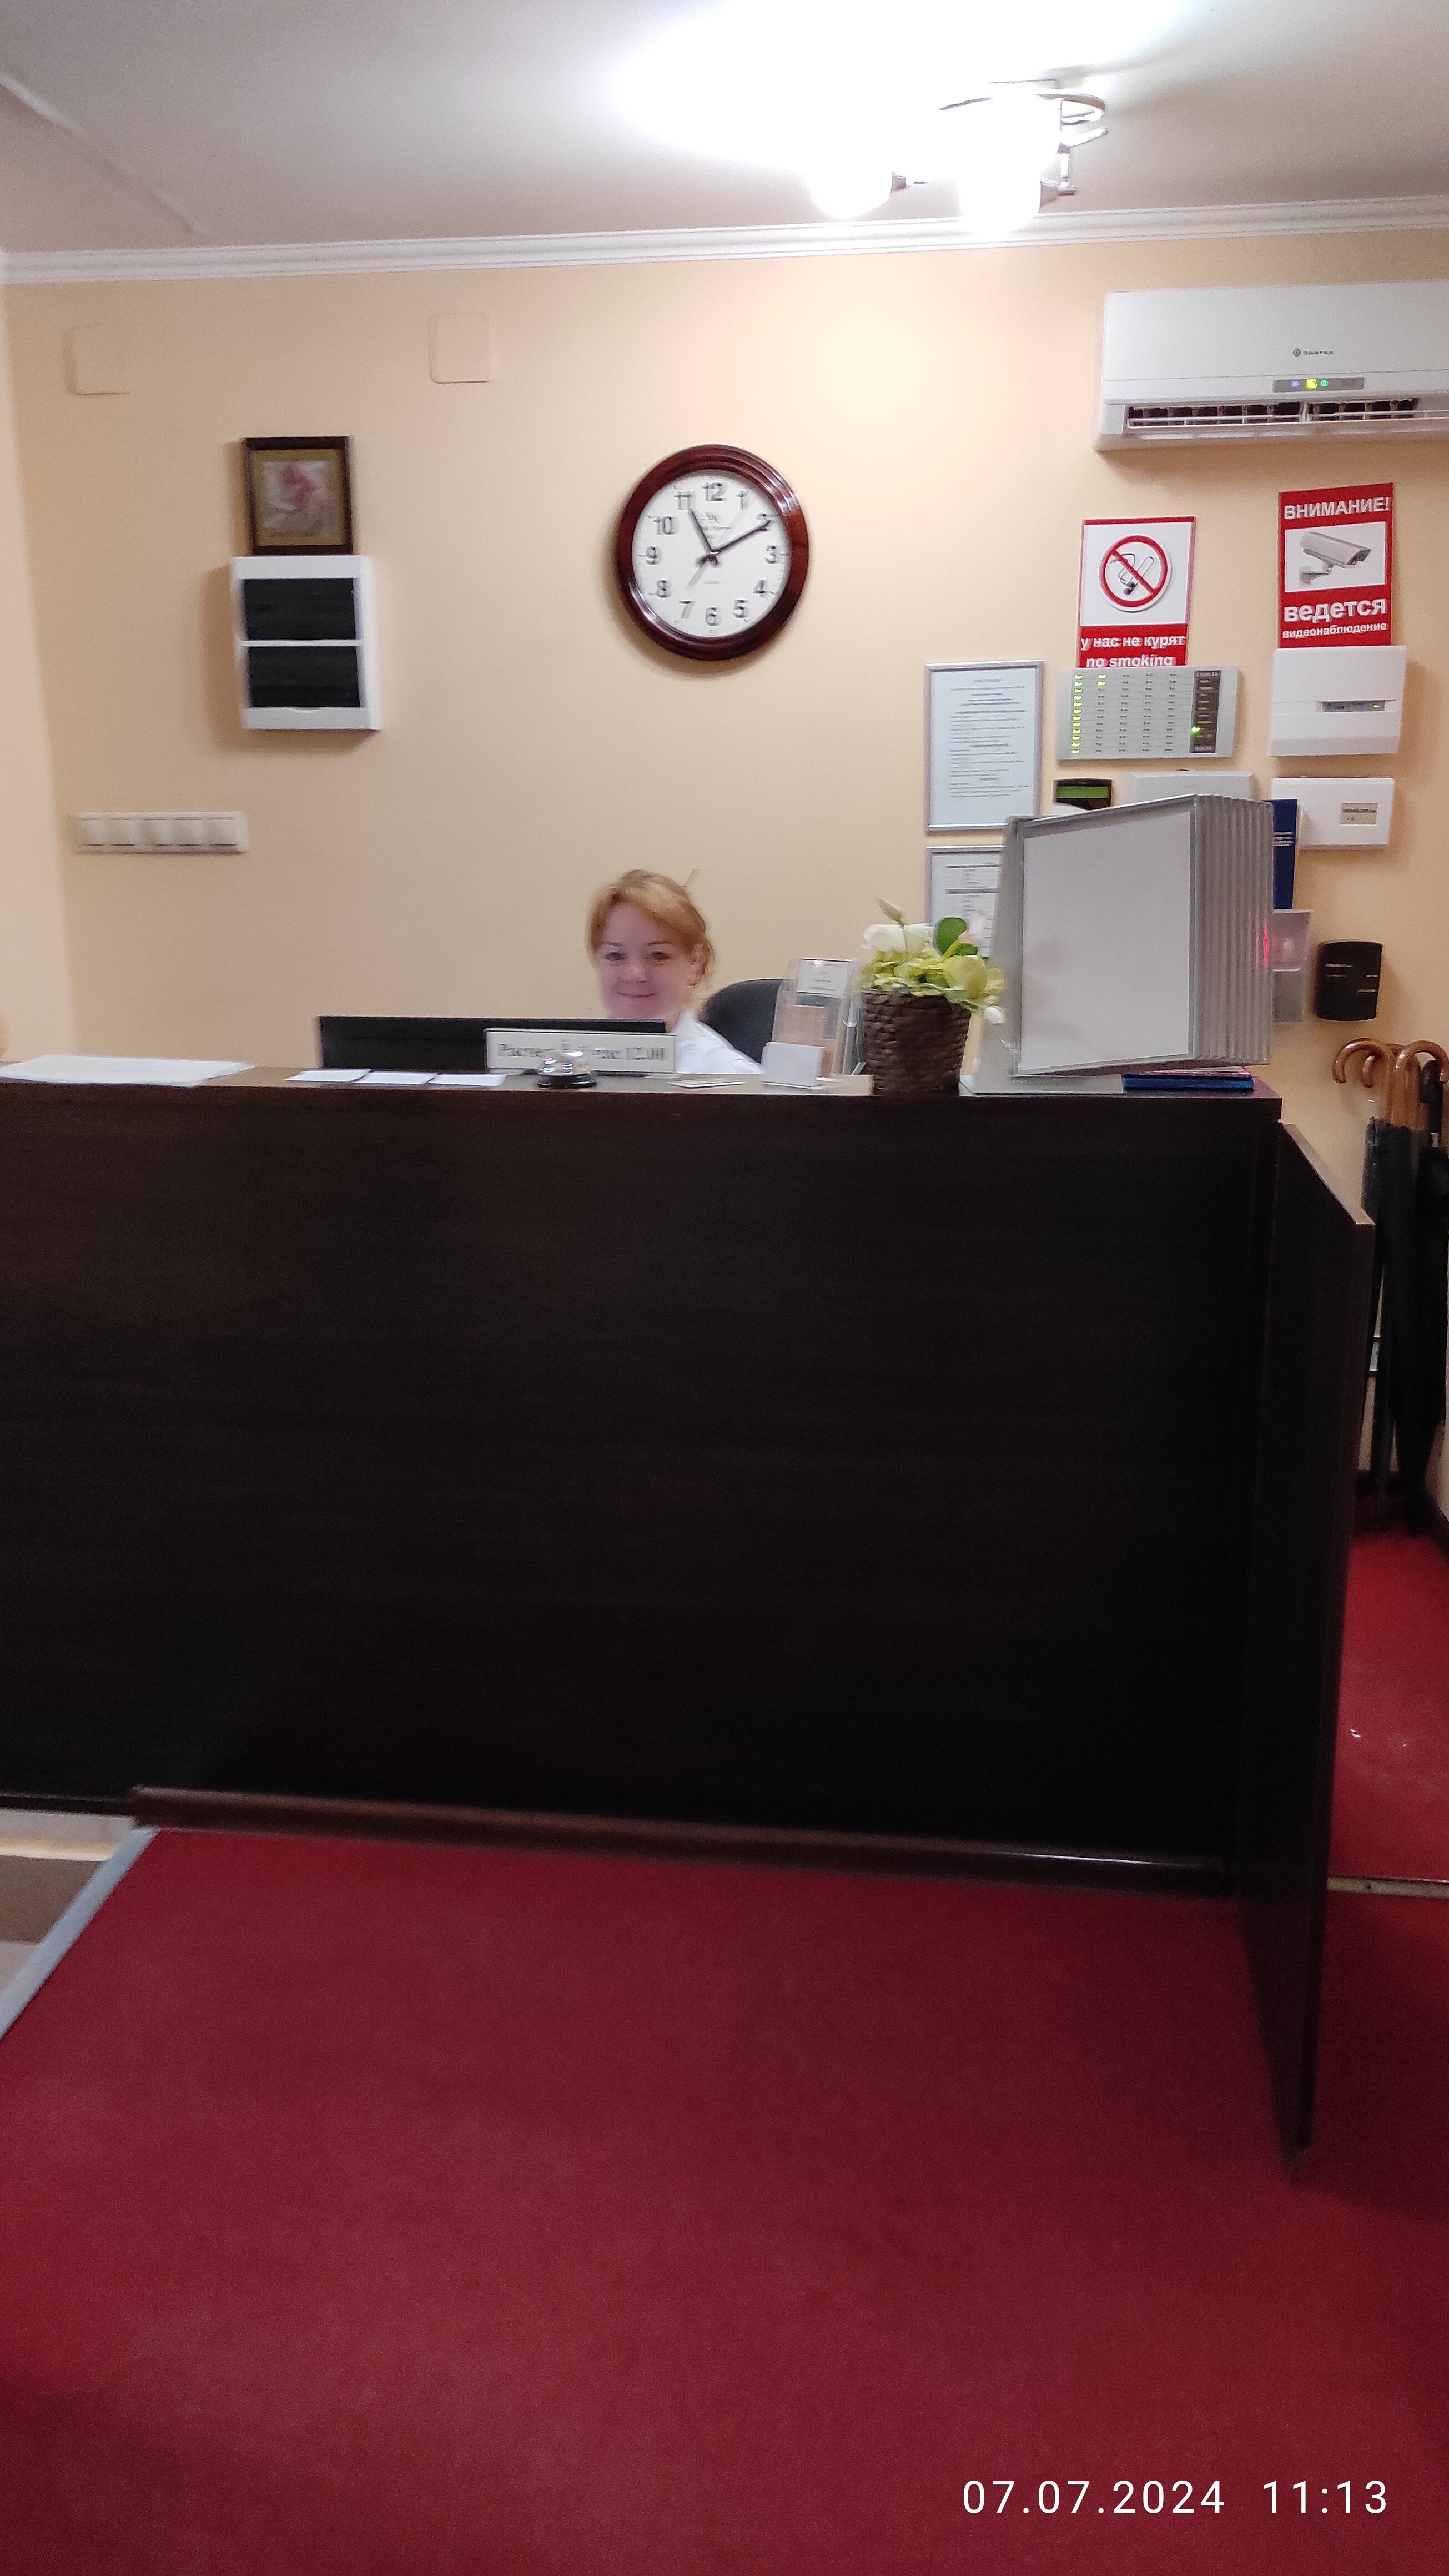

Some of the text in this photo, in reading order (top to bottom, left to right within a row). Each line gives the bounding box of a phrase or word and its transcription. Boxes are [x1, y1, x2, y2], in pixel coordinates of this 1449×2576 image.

[674, 491, 693, 510] 11
[702, 482, 726, 501] 12
[737, 491, 748, 509] 1
[1284, 497, 1390, 520] ВНИМАНИЕ!
[653, 516, 675, 535] 10
[756, 512, 769, 531] 2
[645, 546, 659, 565] 9
[764, 545, 777, 564] 3
[656, 579, 670, 598] 8
[753, 579, 766, 597] 4
[680, 600, 694, 619] 7
[705, 606, 719, 626] 6
[733, 599, 747, 618] 5
[1284, 598, 1387, 623] ведется
[1282, 623, 1387, 638] видеонаблюдение
[1080, 636, 1186, 651] у нас не курят
[1086, 653, 1175, 667] no smoking
